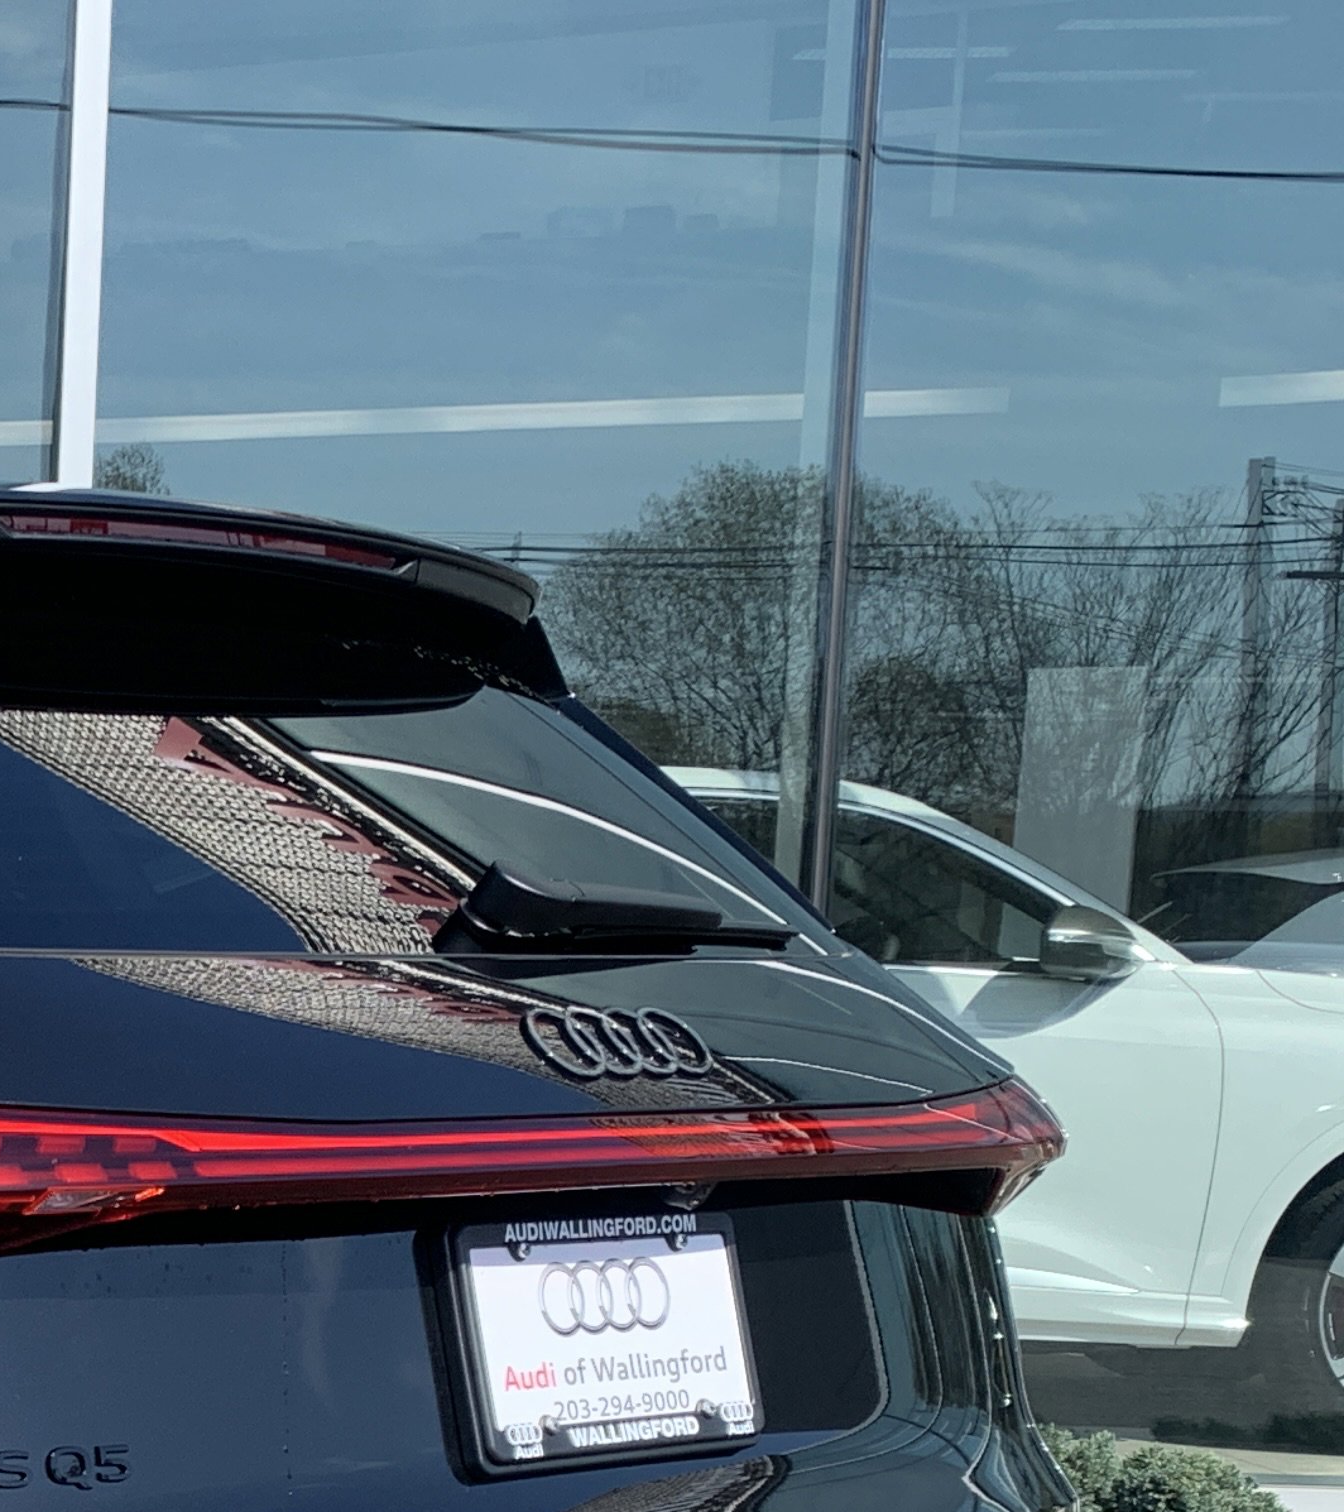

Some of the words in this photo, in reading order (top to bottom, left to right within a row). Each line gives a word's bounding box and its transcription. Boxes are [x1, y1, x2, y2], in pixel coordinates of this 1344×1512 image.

[504, 1214, 697, 1243] AUDIWALLINGFORD.COM
[504, 1361, 557, 1392] Audi
[563, 1360, 587, 1386] of
[591, 1346, 727, 1383] Wallingford
[553, 1389, 690, 1421] 203-294-9000
[566, 1416, 700, 1447] WALLINGFORD
[727, 1421, 755, 1436] Audi
[515, 1445, 544, 1459] Audi
